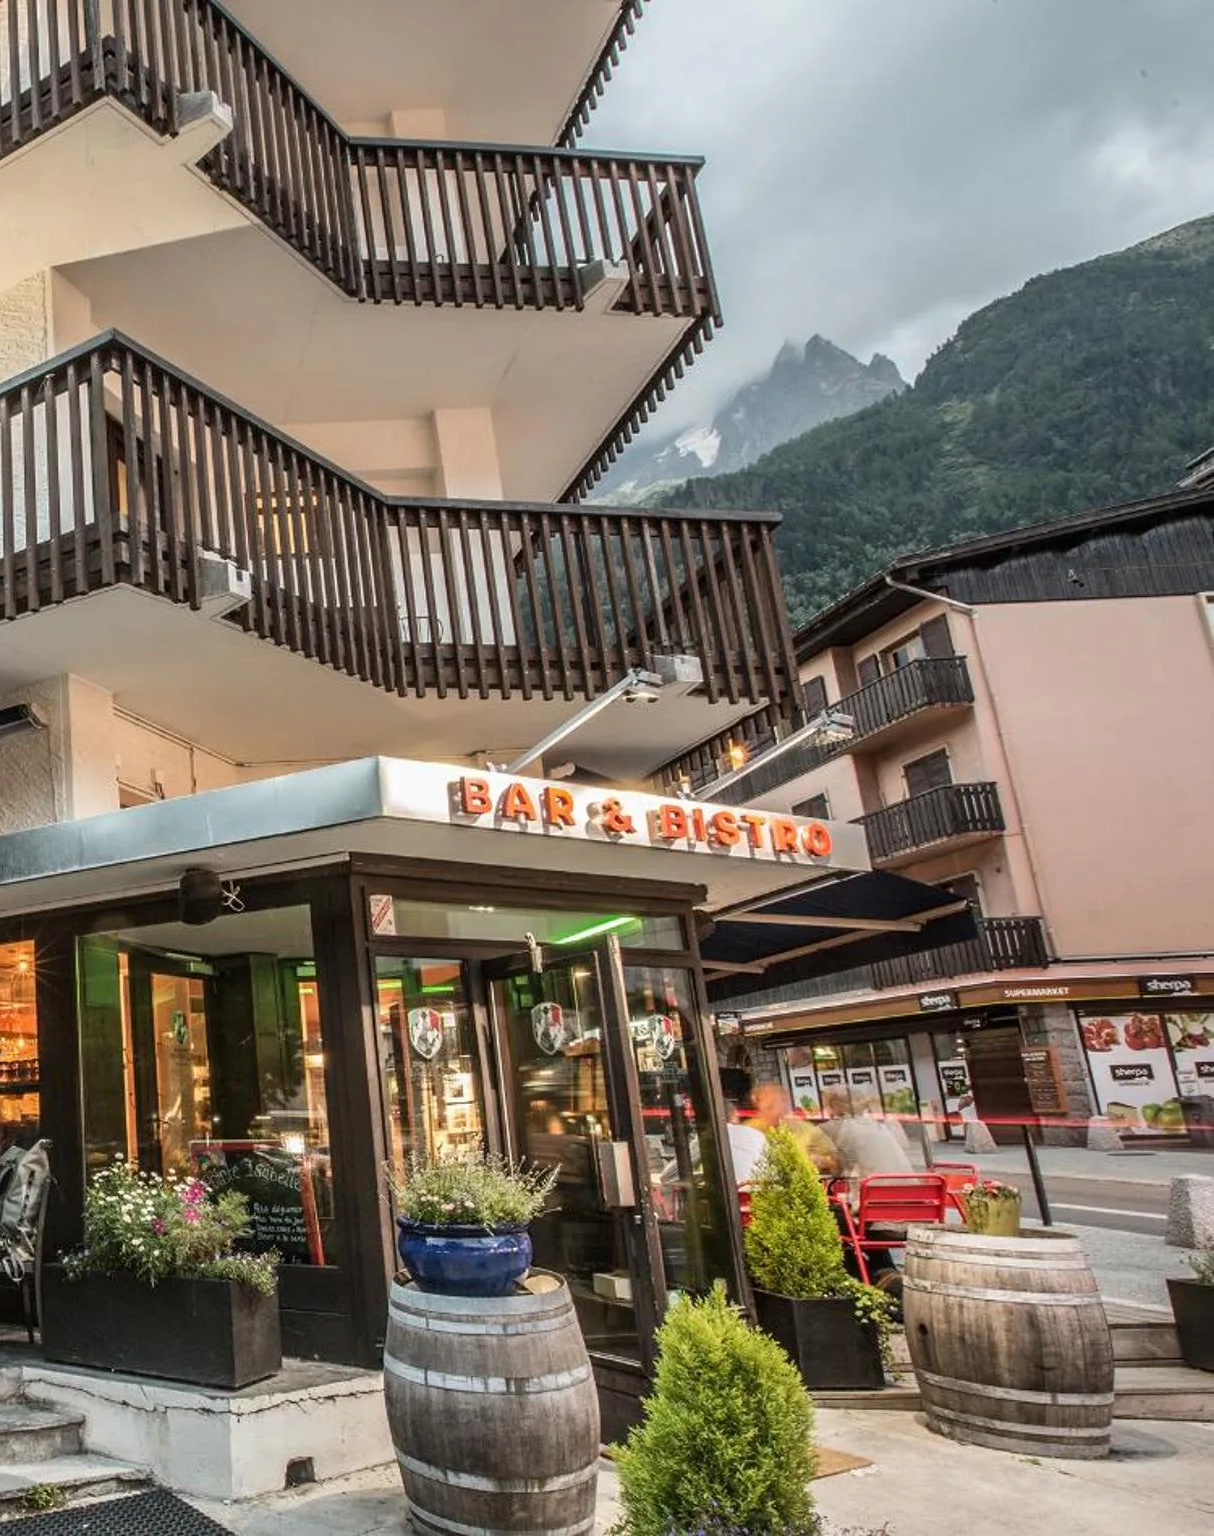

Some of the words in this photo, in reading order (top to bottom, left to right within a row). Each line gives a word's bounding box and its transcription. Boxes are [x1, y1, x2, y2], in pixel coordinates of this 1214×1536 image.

[460, 776, 576, 826] BAR
[601, 797, 637, 834] &
[659, 804, 833, 858] BISTRO
[1146, 979, 1192, 991] sherpa
[1003, 986, 1070, 998] SUPERMARKET
[1114, 1067, 1148, 1078] sherpa
